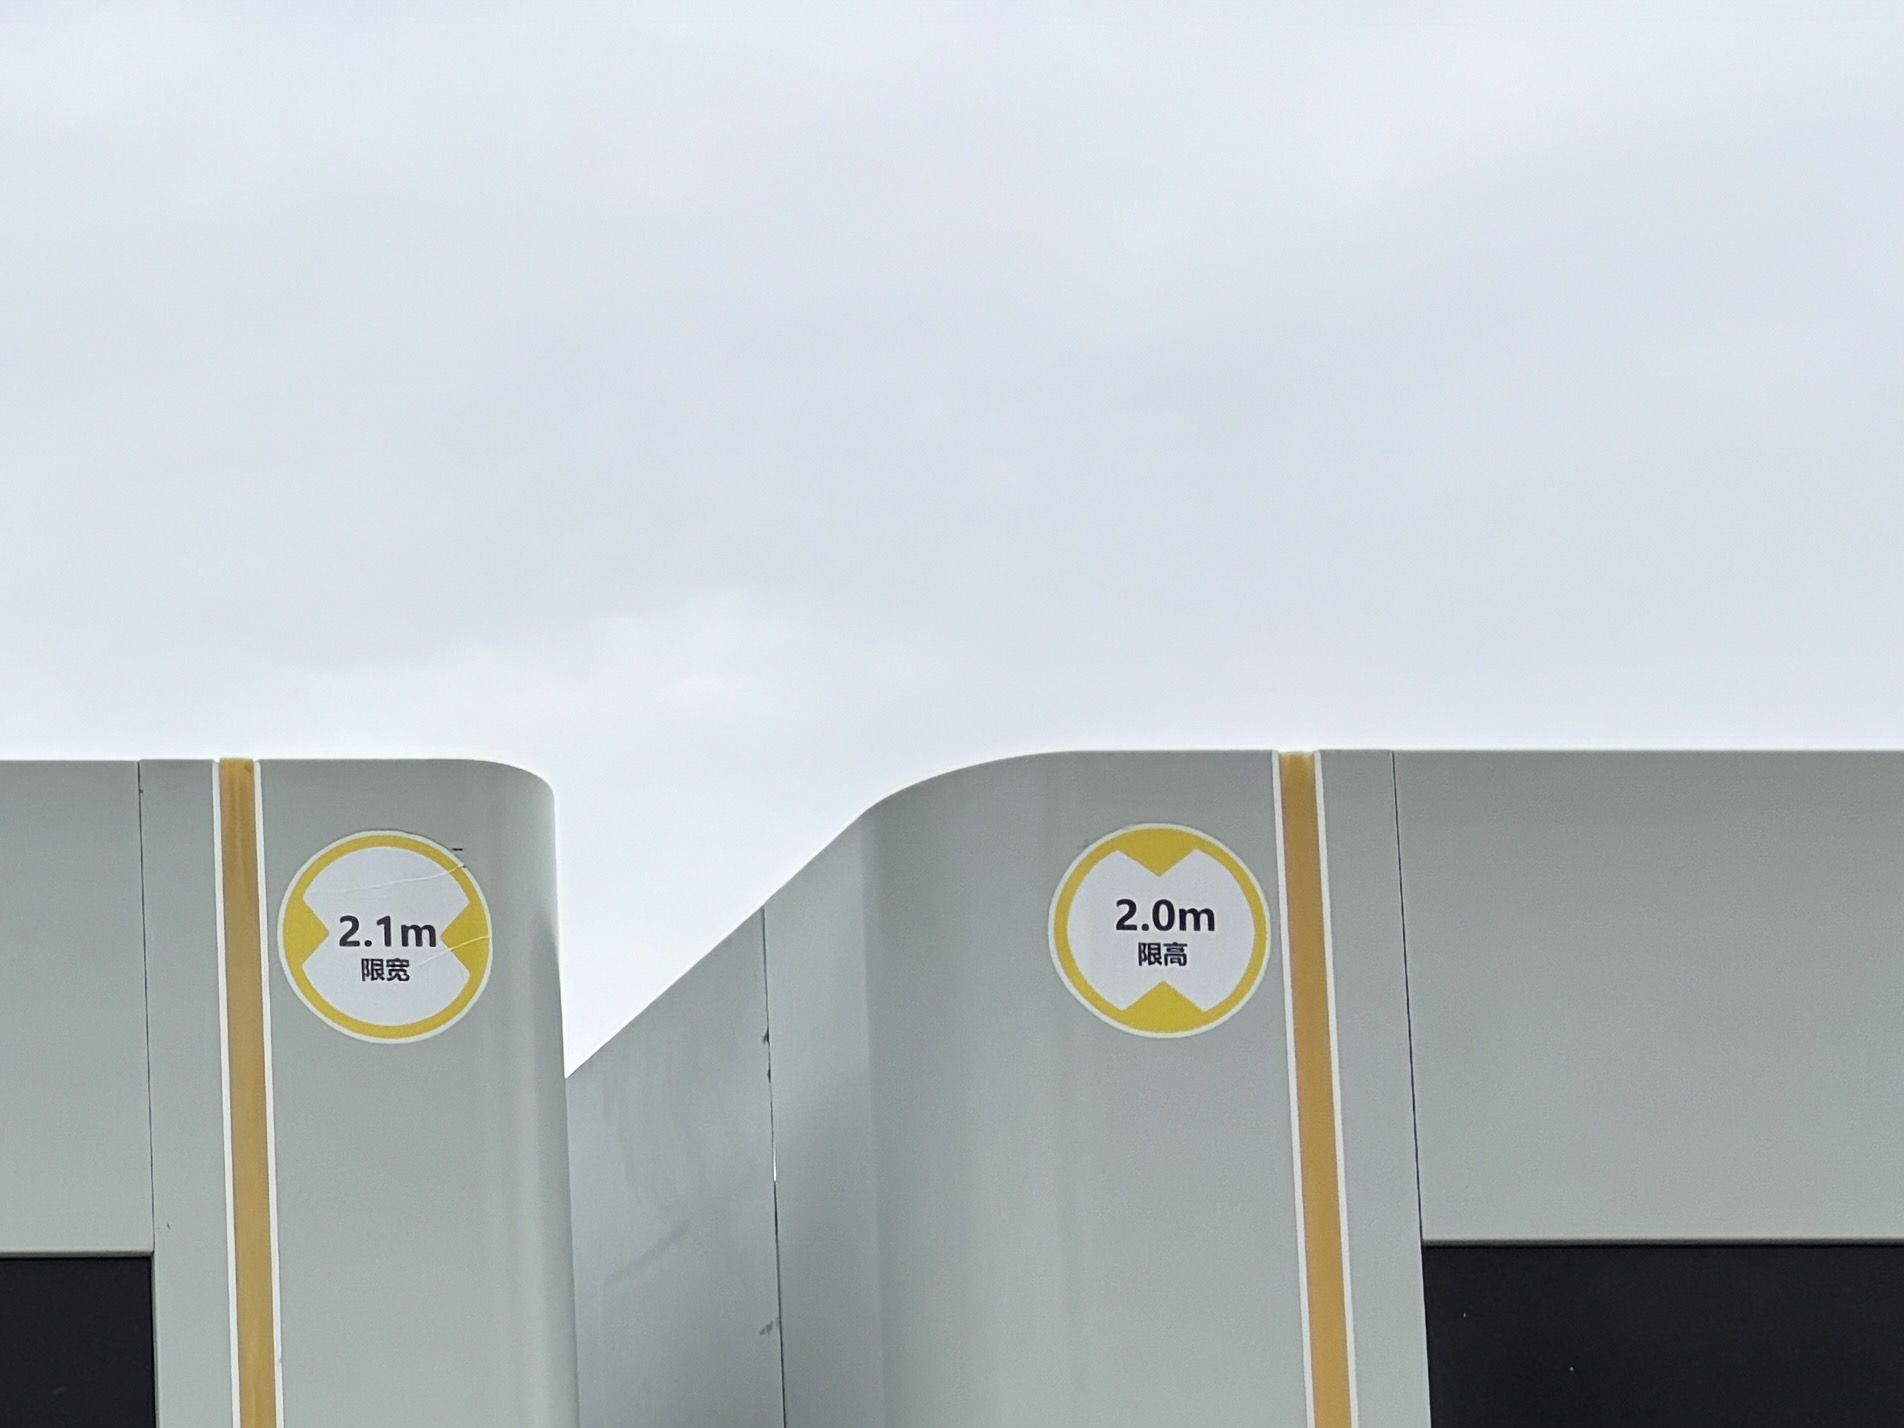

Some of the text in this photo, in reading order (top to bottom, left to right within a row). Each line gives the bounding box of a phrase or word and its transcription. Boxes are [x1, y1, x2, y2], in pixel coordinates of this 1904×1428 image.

[1115, 898, 1215, 932] 2.0m
[339, 915, 437, 948] 2.1m
[1137, 941, 1188, 967] 限高
[360, 957, 411, 982] 限宽
